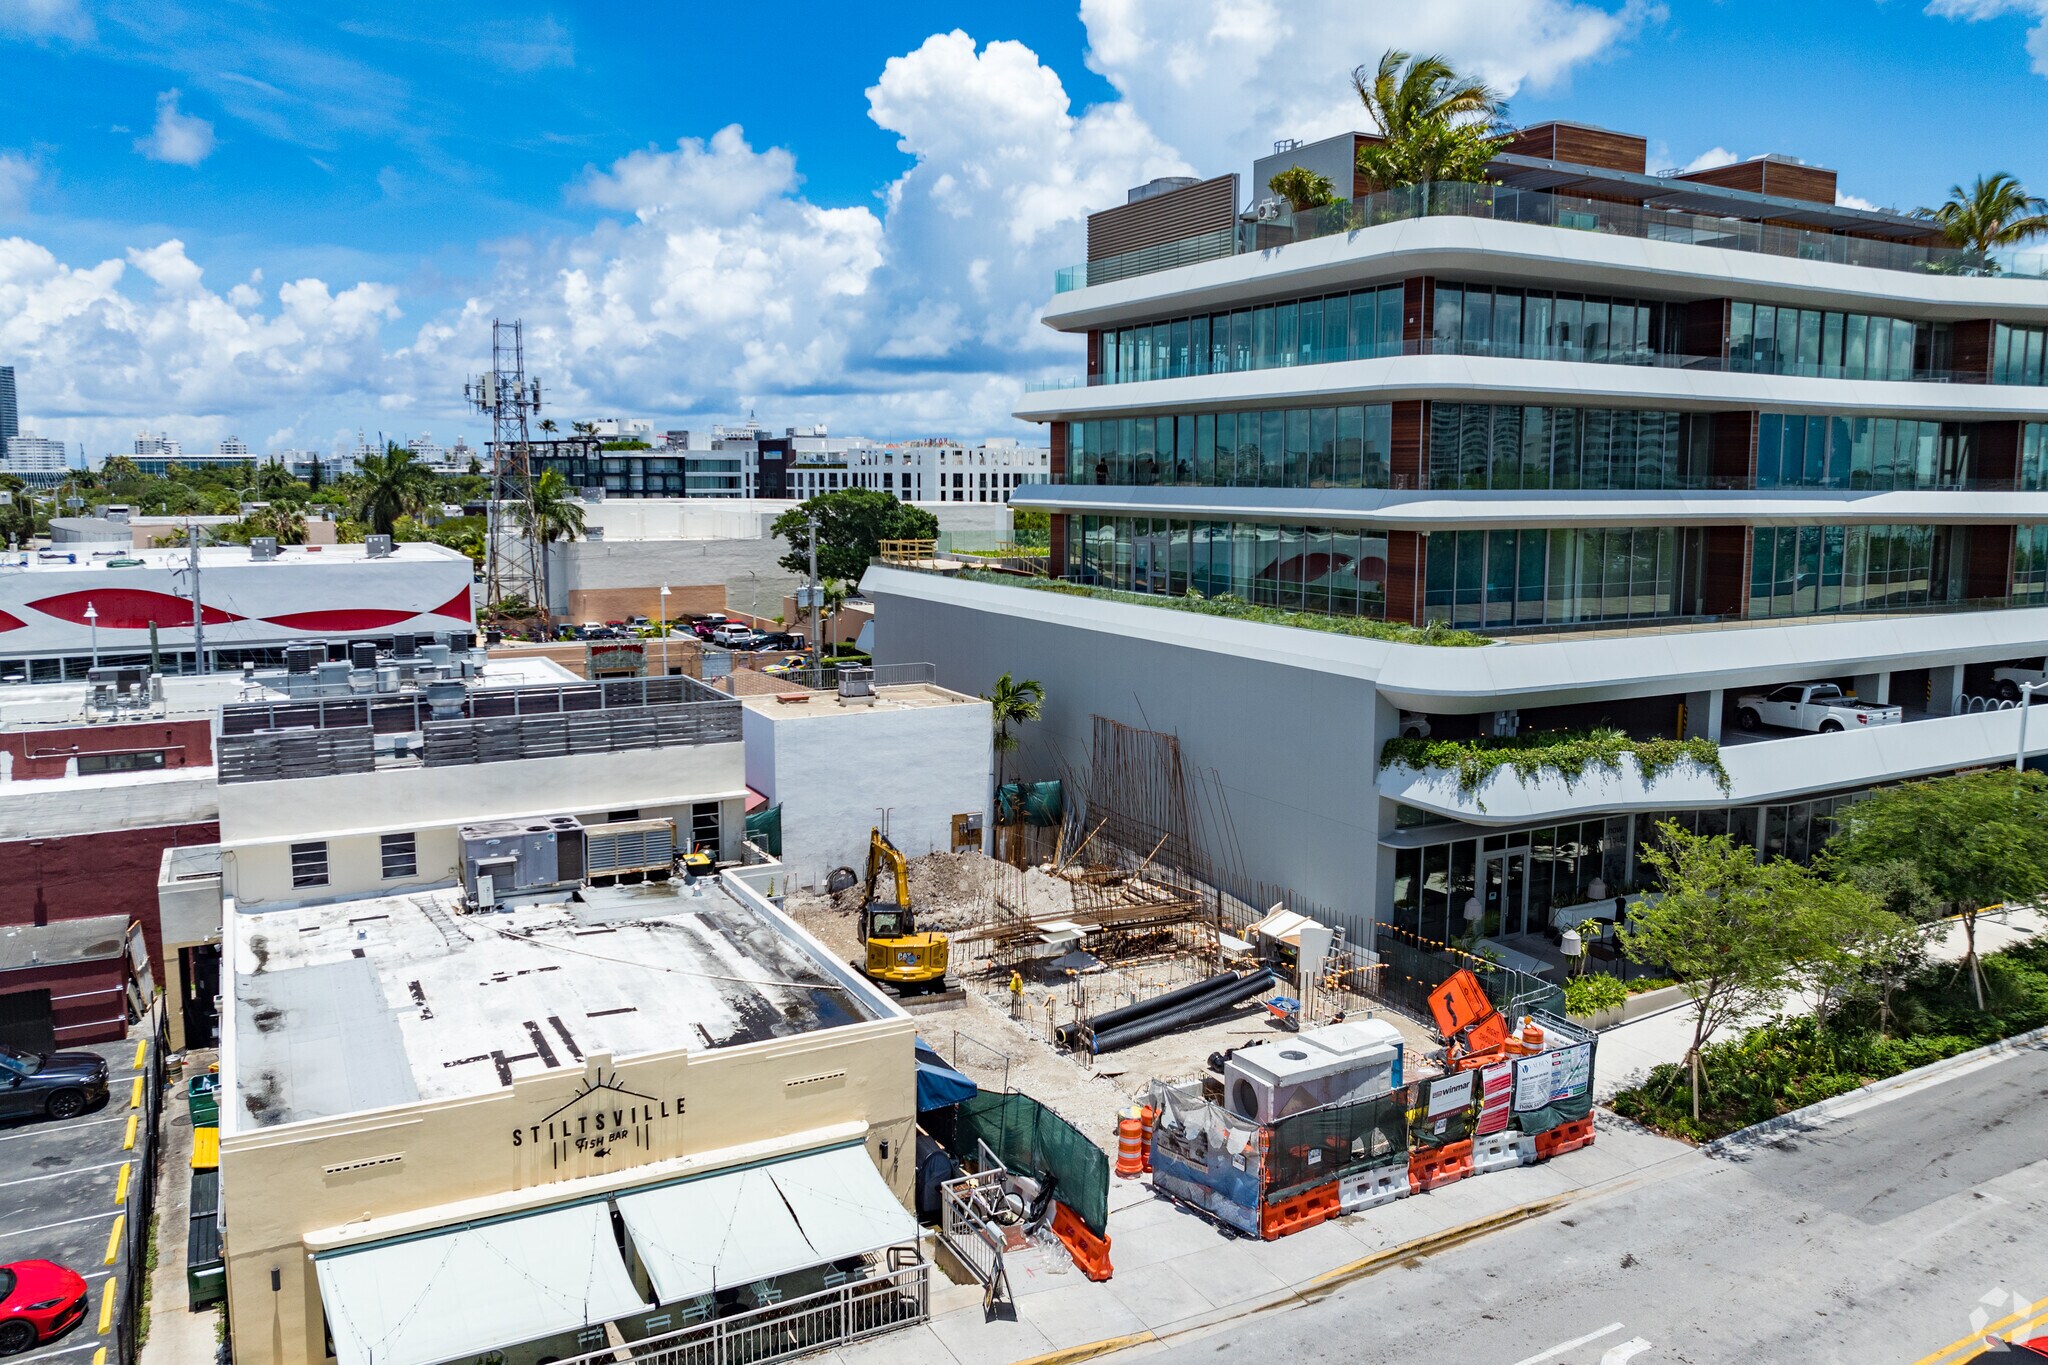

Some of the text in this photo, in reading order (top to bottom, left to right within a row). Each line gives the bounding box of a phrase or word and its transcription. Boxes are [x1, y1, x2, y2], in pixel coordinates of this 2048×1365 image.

[1442, 1081, 1471, 1096] winmar
[512, 1097, 686, 1146] STILTSVILLE
[608, 1129, 629, 1142] BAR
